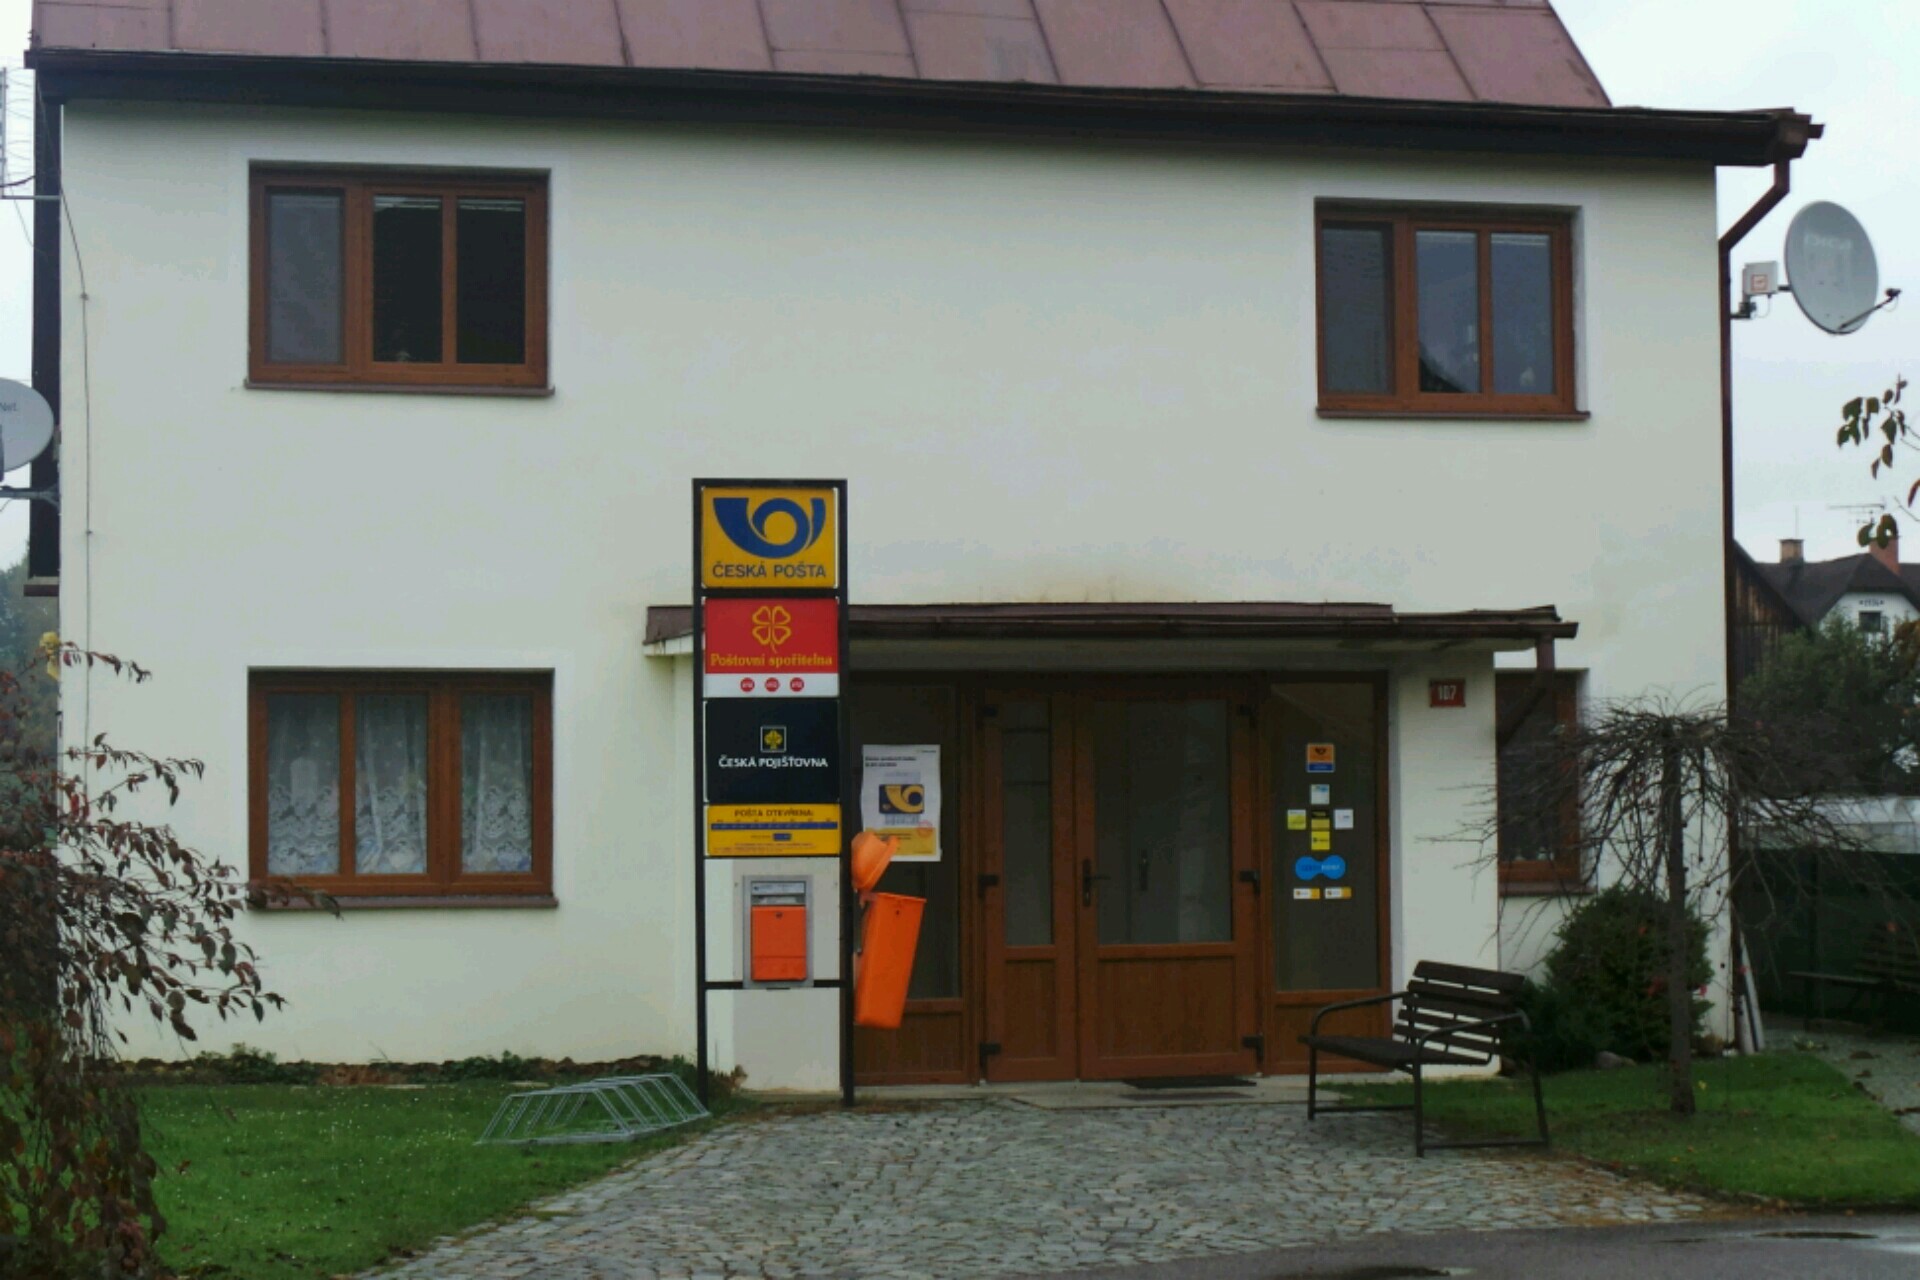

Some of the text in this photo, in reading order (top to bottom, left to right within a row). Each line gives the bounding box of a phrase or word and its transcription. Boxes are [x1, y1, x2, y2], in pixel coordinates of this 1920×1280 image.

[713, 561, 827, 579] ČESKÁ POŠTA
[710, 652, 833, 669] Poštovní spořitelna
[718, 755, 757, 768] ČESKÁ
[734, 807, 763, 817] POŠTA
